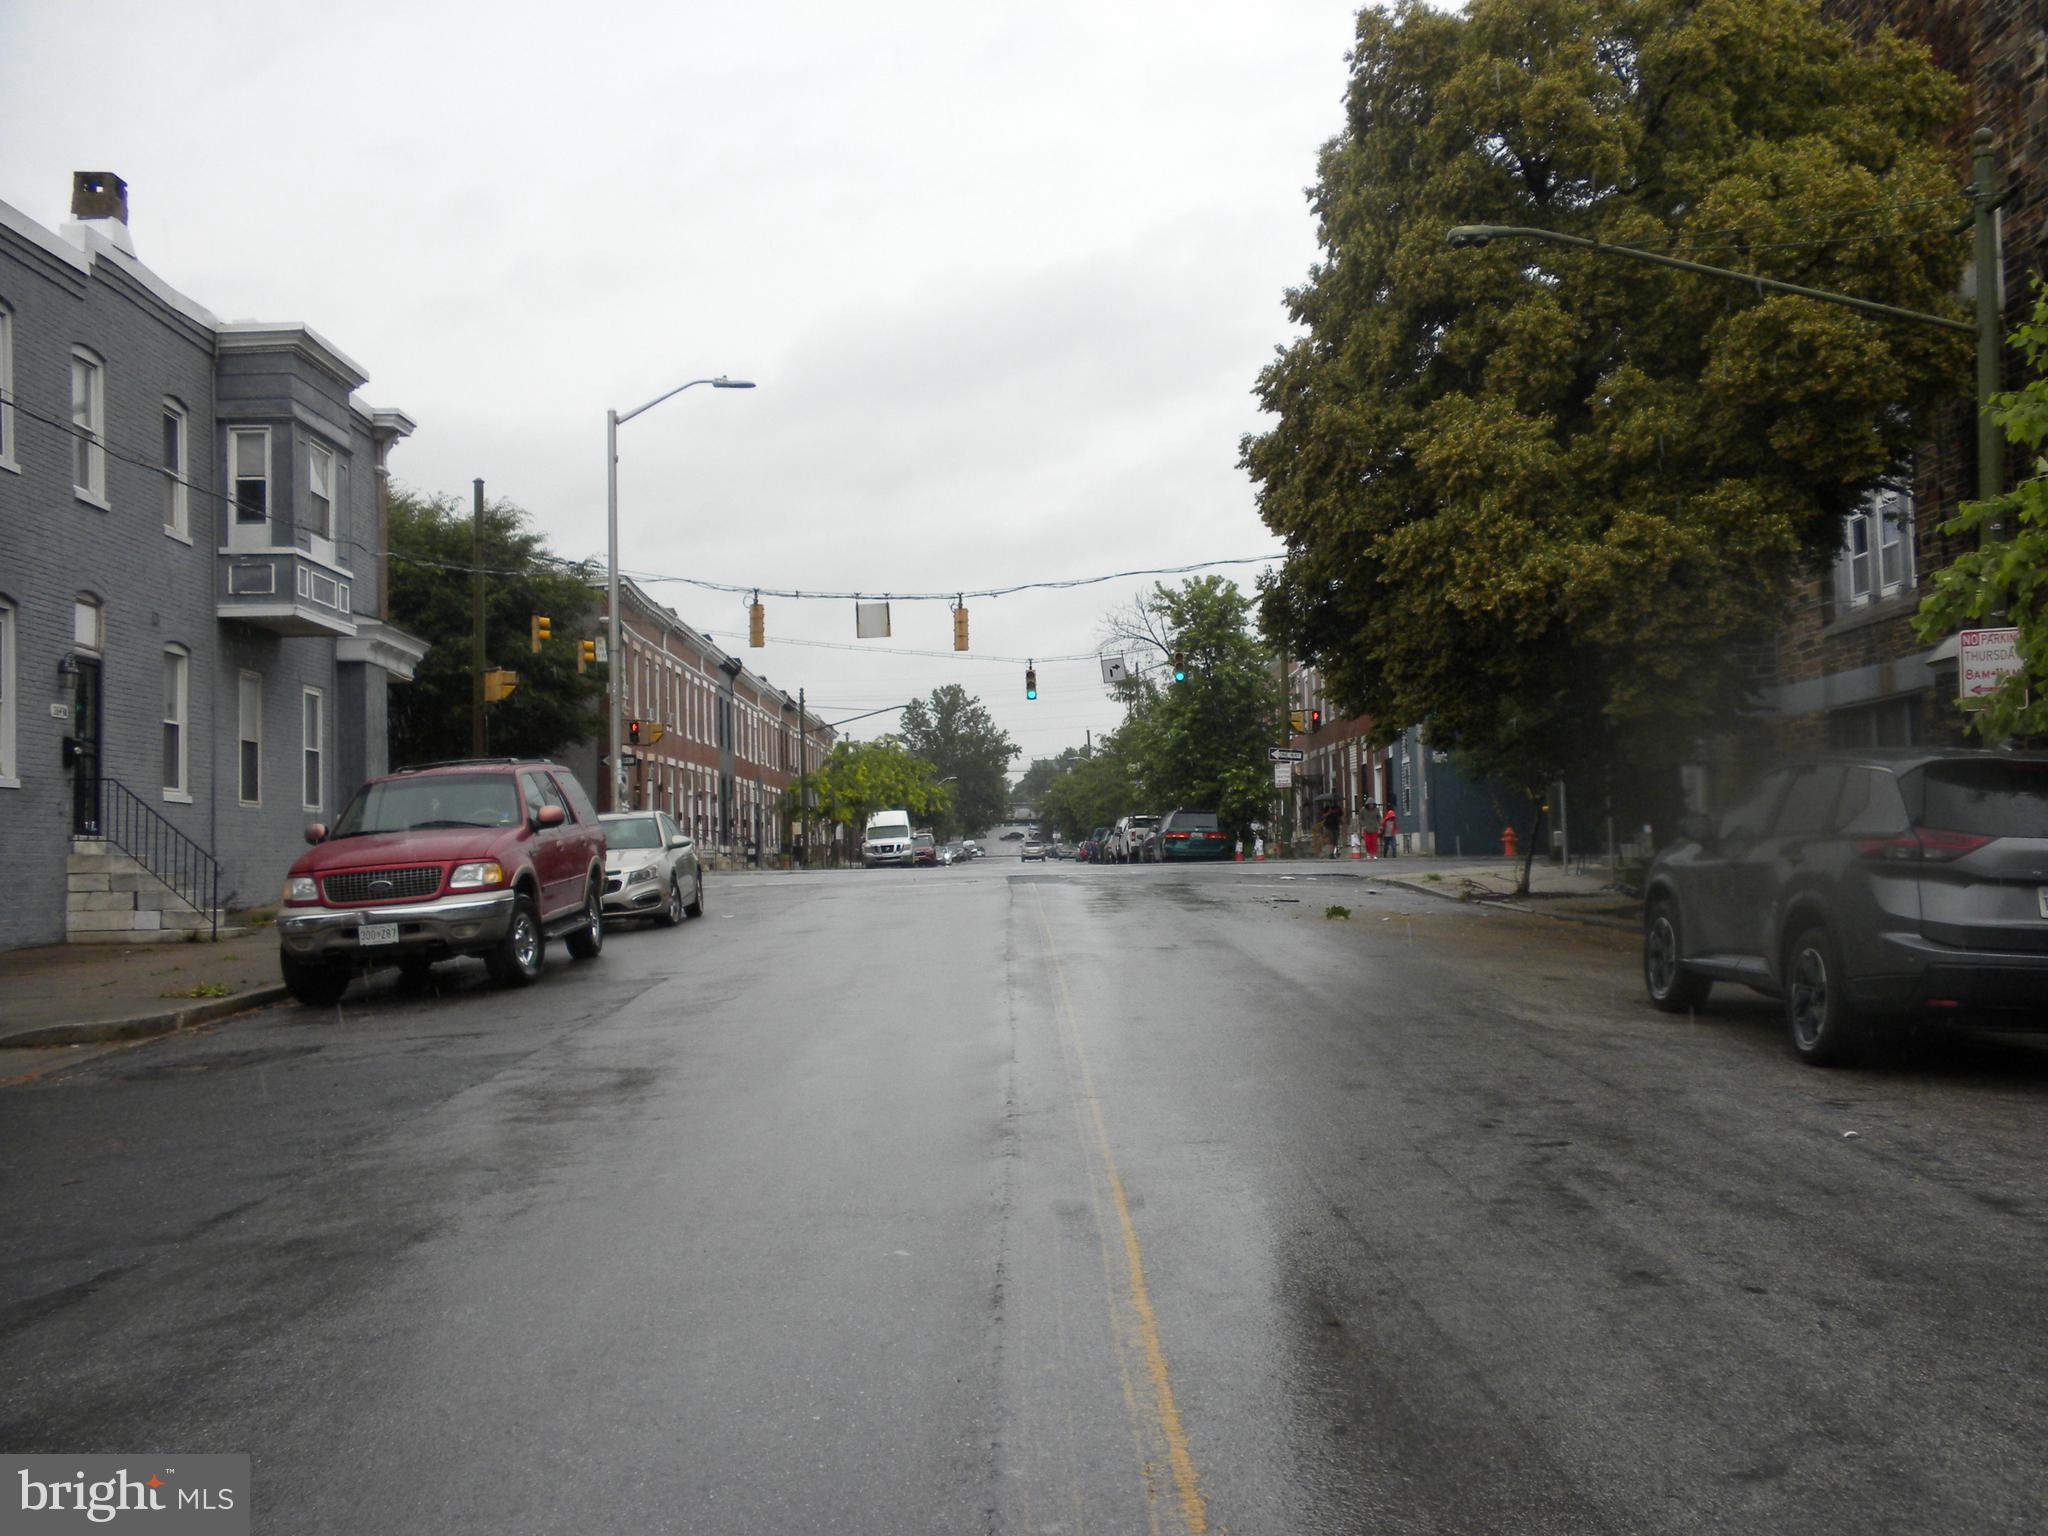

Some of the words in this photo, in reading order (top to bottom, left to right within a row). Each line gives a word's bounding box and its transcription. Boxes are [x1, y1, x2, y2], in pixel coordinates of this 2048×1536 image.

[1962, 634, 1979, 646] NO
[1981, 632, 2017, 645] PARKIN
[1965, 648, 2016, 661] THURSDA
